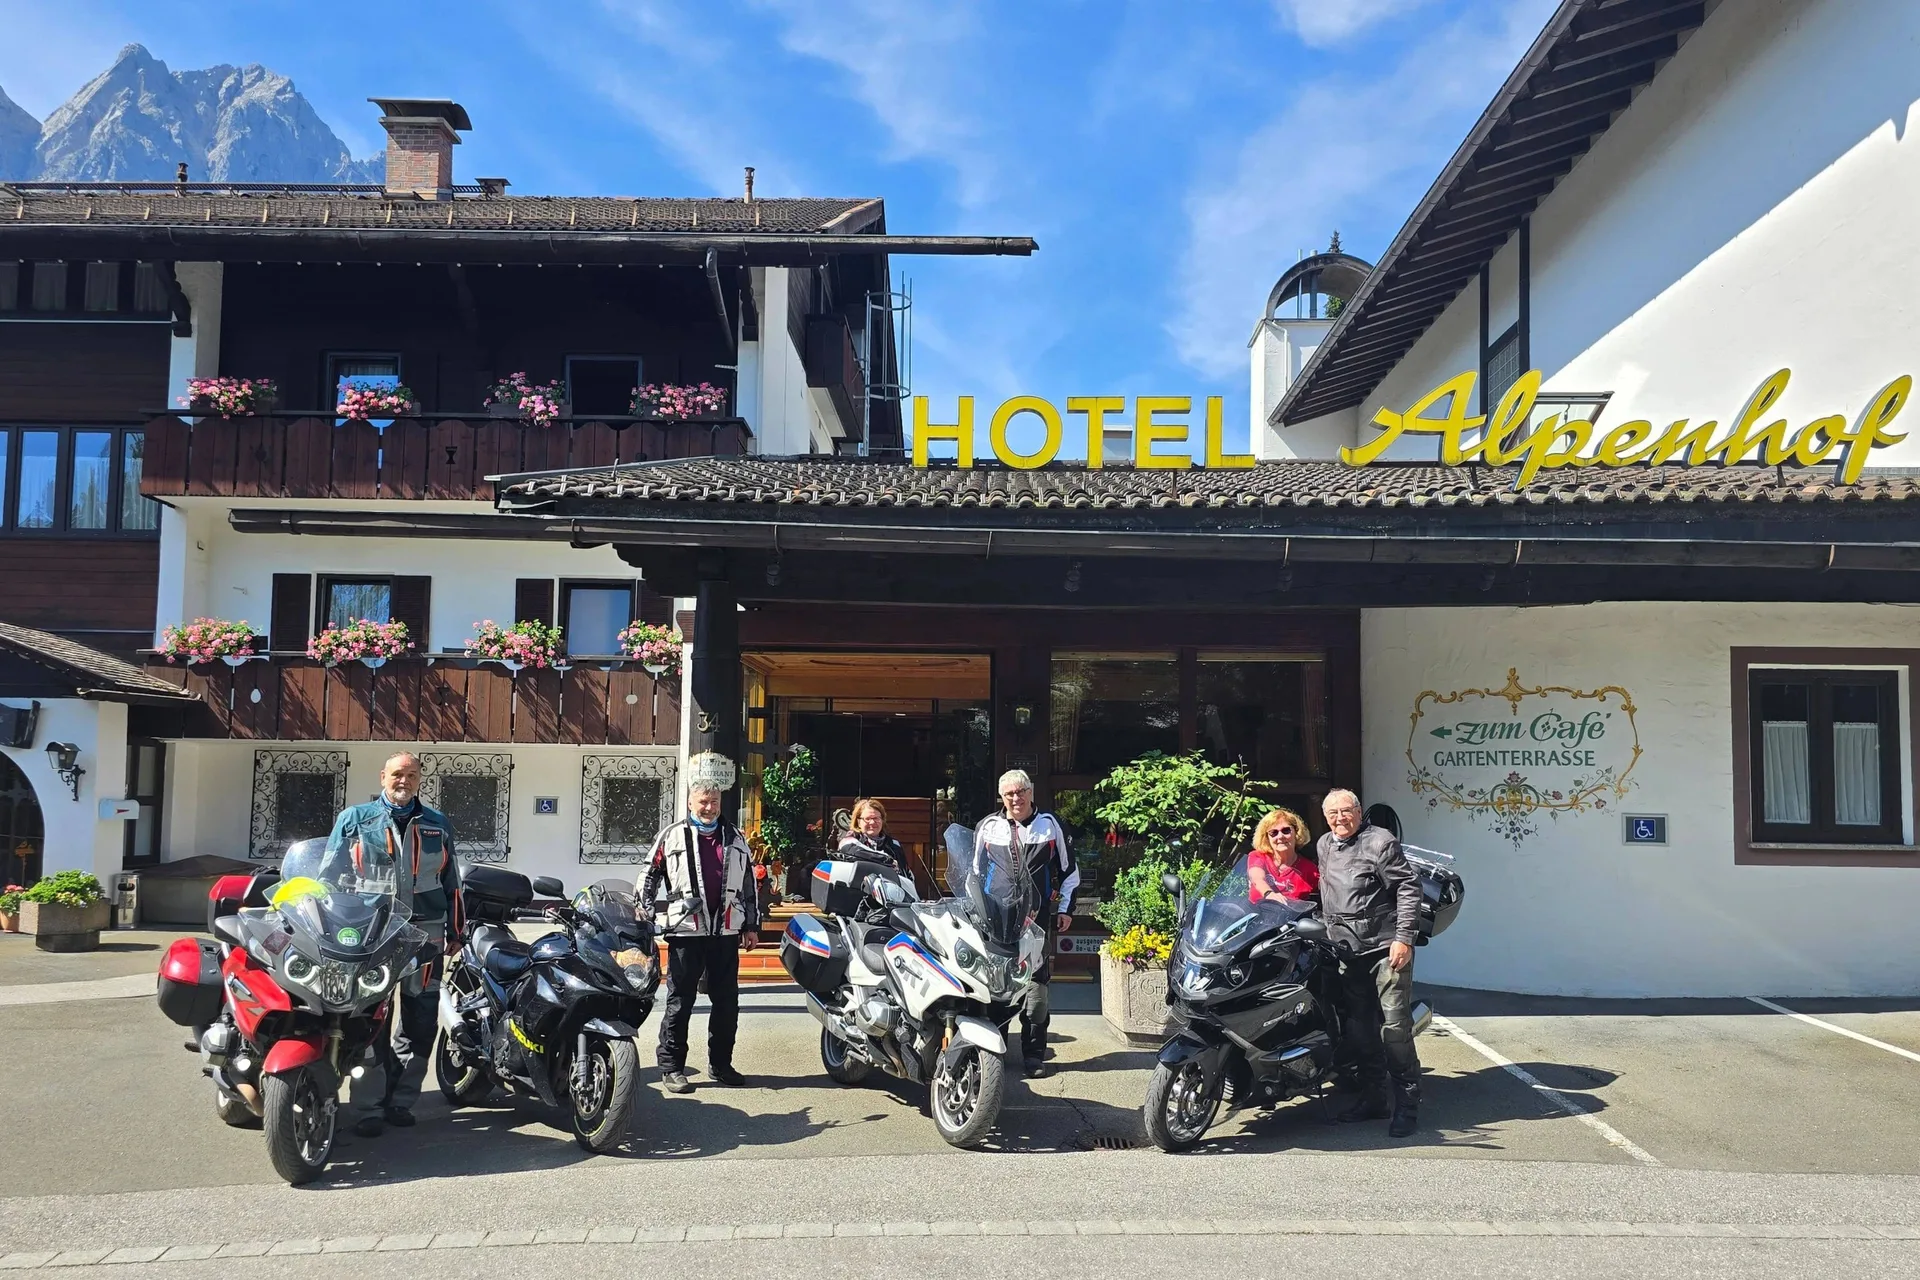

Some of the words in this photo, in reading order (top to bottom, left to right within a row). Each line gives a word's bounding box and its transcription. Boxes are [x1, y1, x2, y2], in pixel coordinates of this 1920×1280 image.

[912, 396, 1257, 469] HOTEL
[1340, 368, 1912, 489] Alpenhof
[698, 712, 721, 733] 34
[1455, 721, 1526, 746] Zum
[1434, 750, 1596, 767] GARTENTERRASSE
